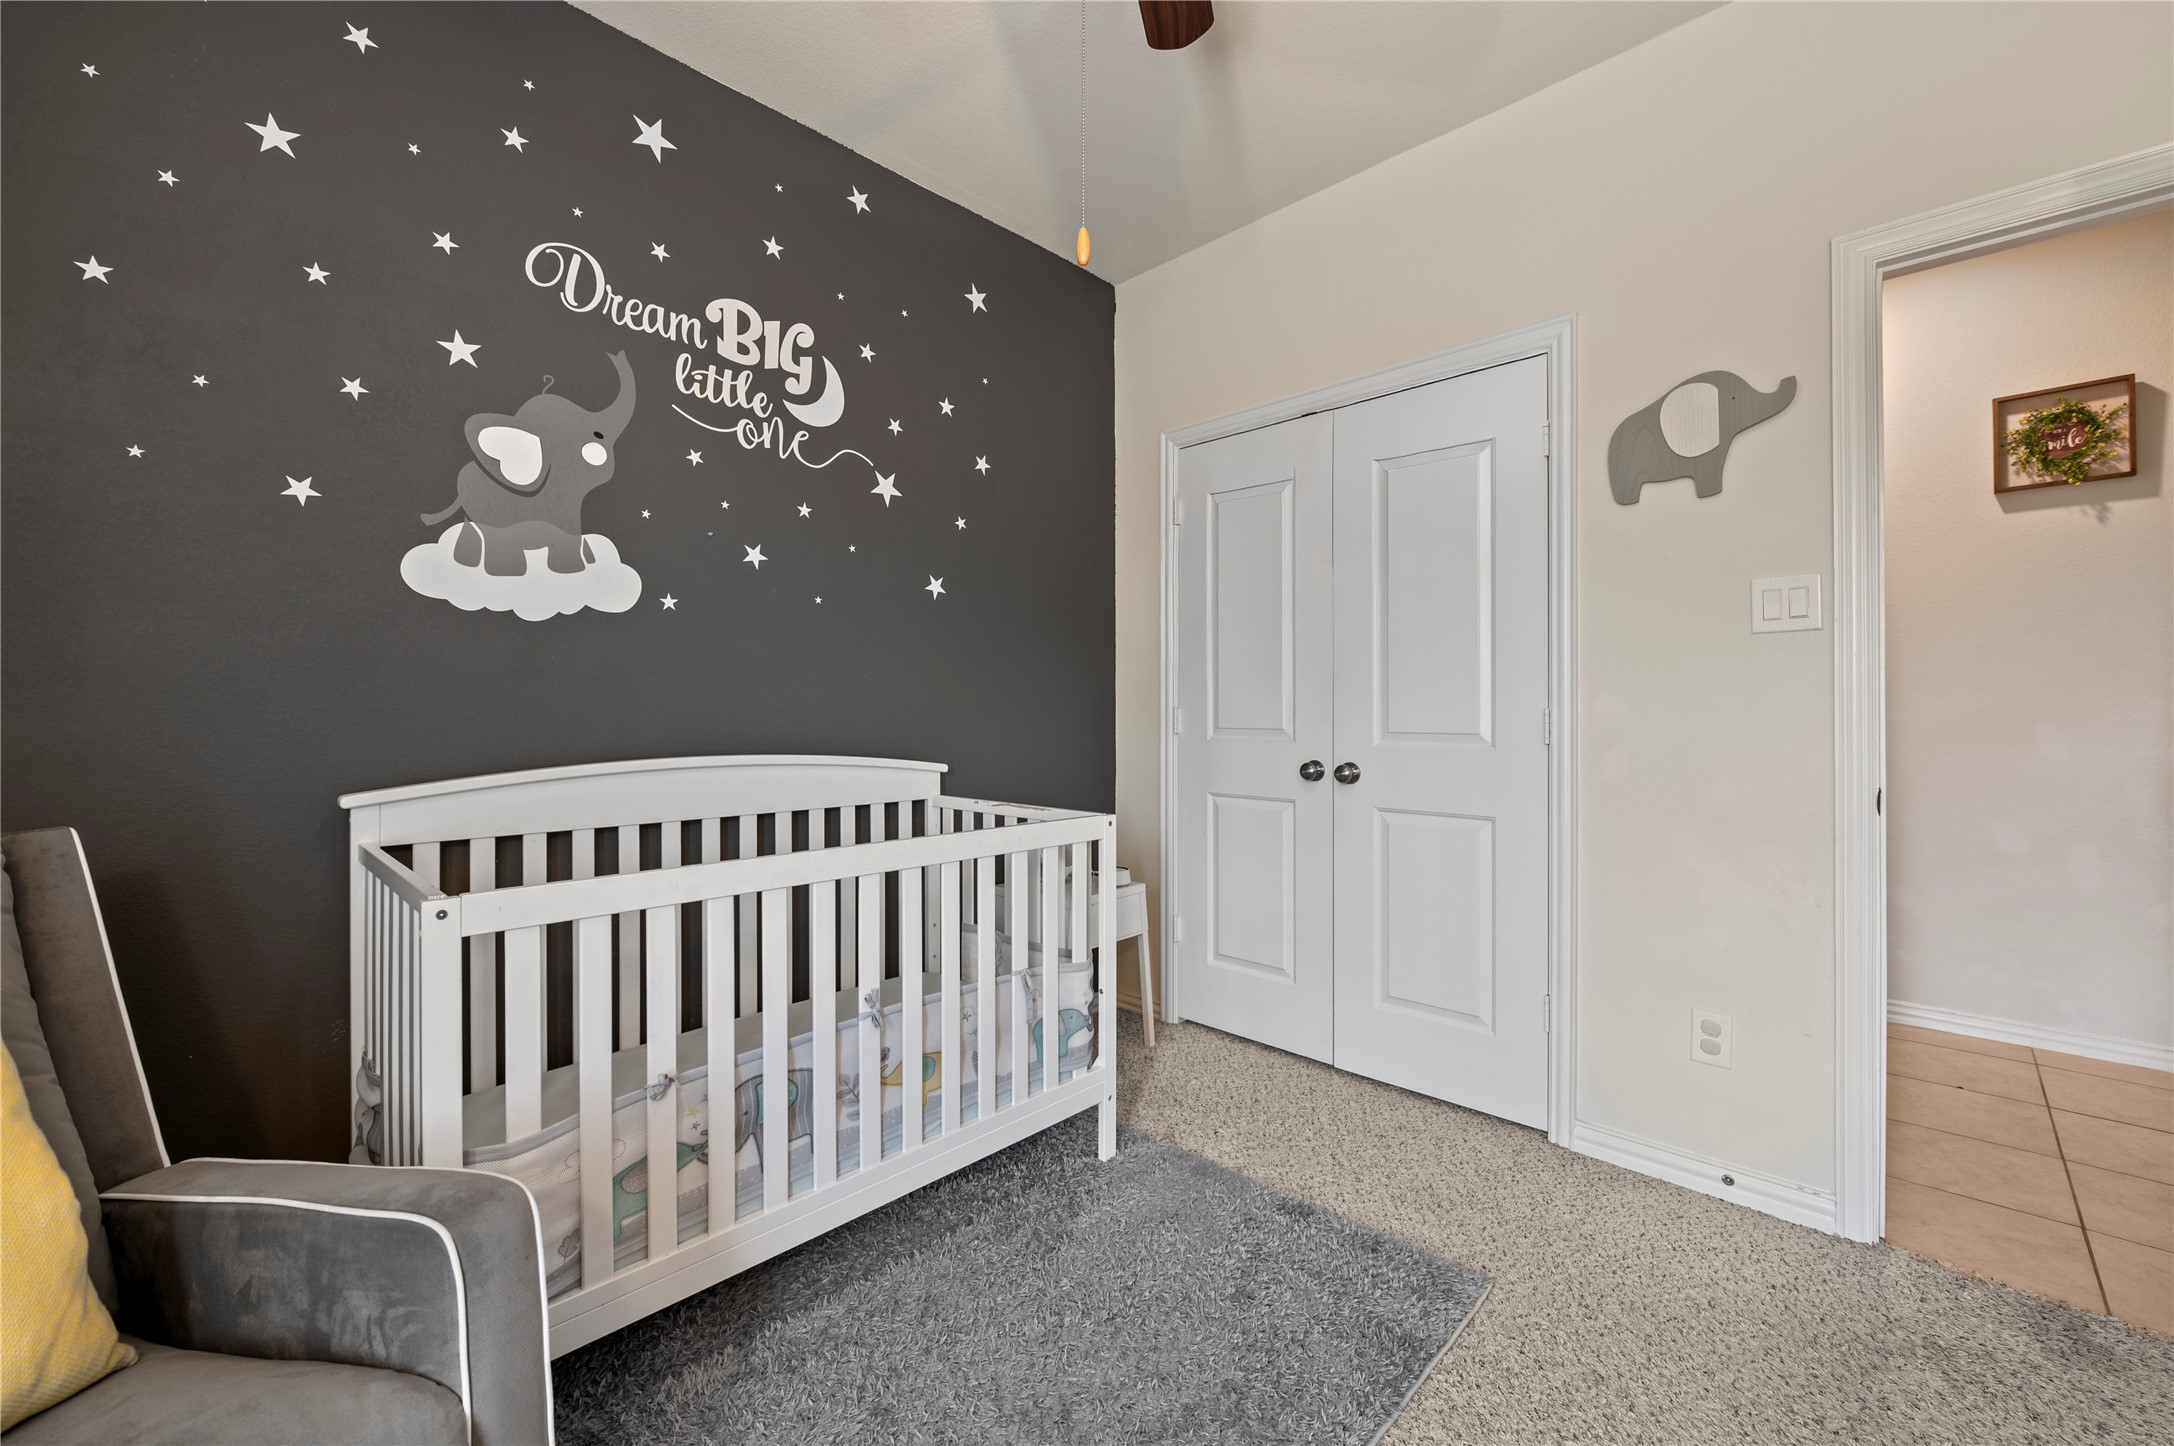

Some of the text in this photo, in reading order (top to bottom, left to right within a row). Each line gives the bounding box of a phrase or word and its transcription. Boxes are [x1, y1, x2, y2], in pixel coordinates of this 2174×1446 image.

[525, 242, 815, 395] Dream BIG
[675, 353, 773, 418] little
[736, 416, 810, 462] one
